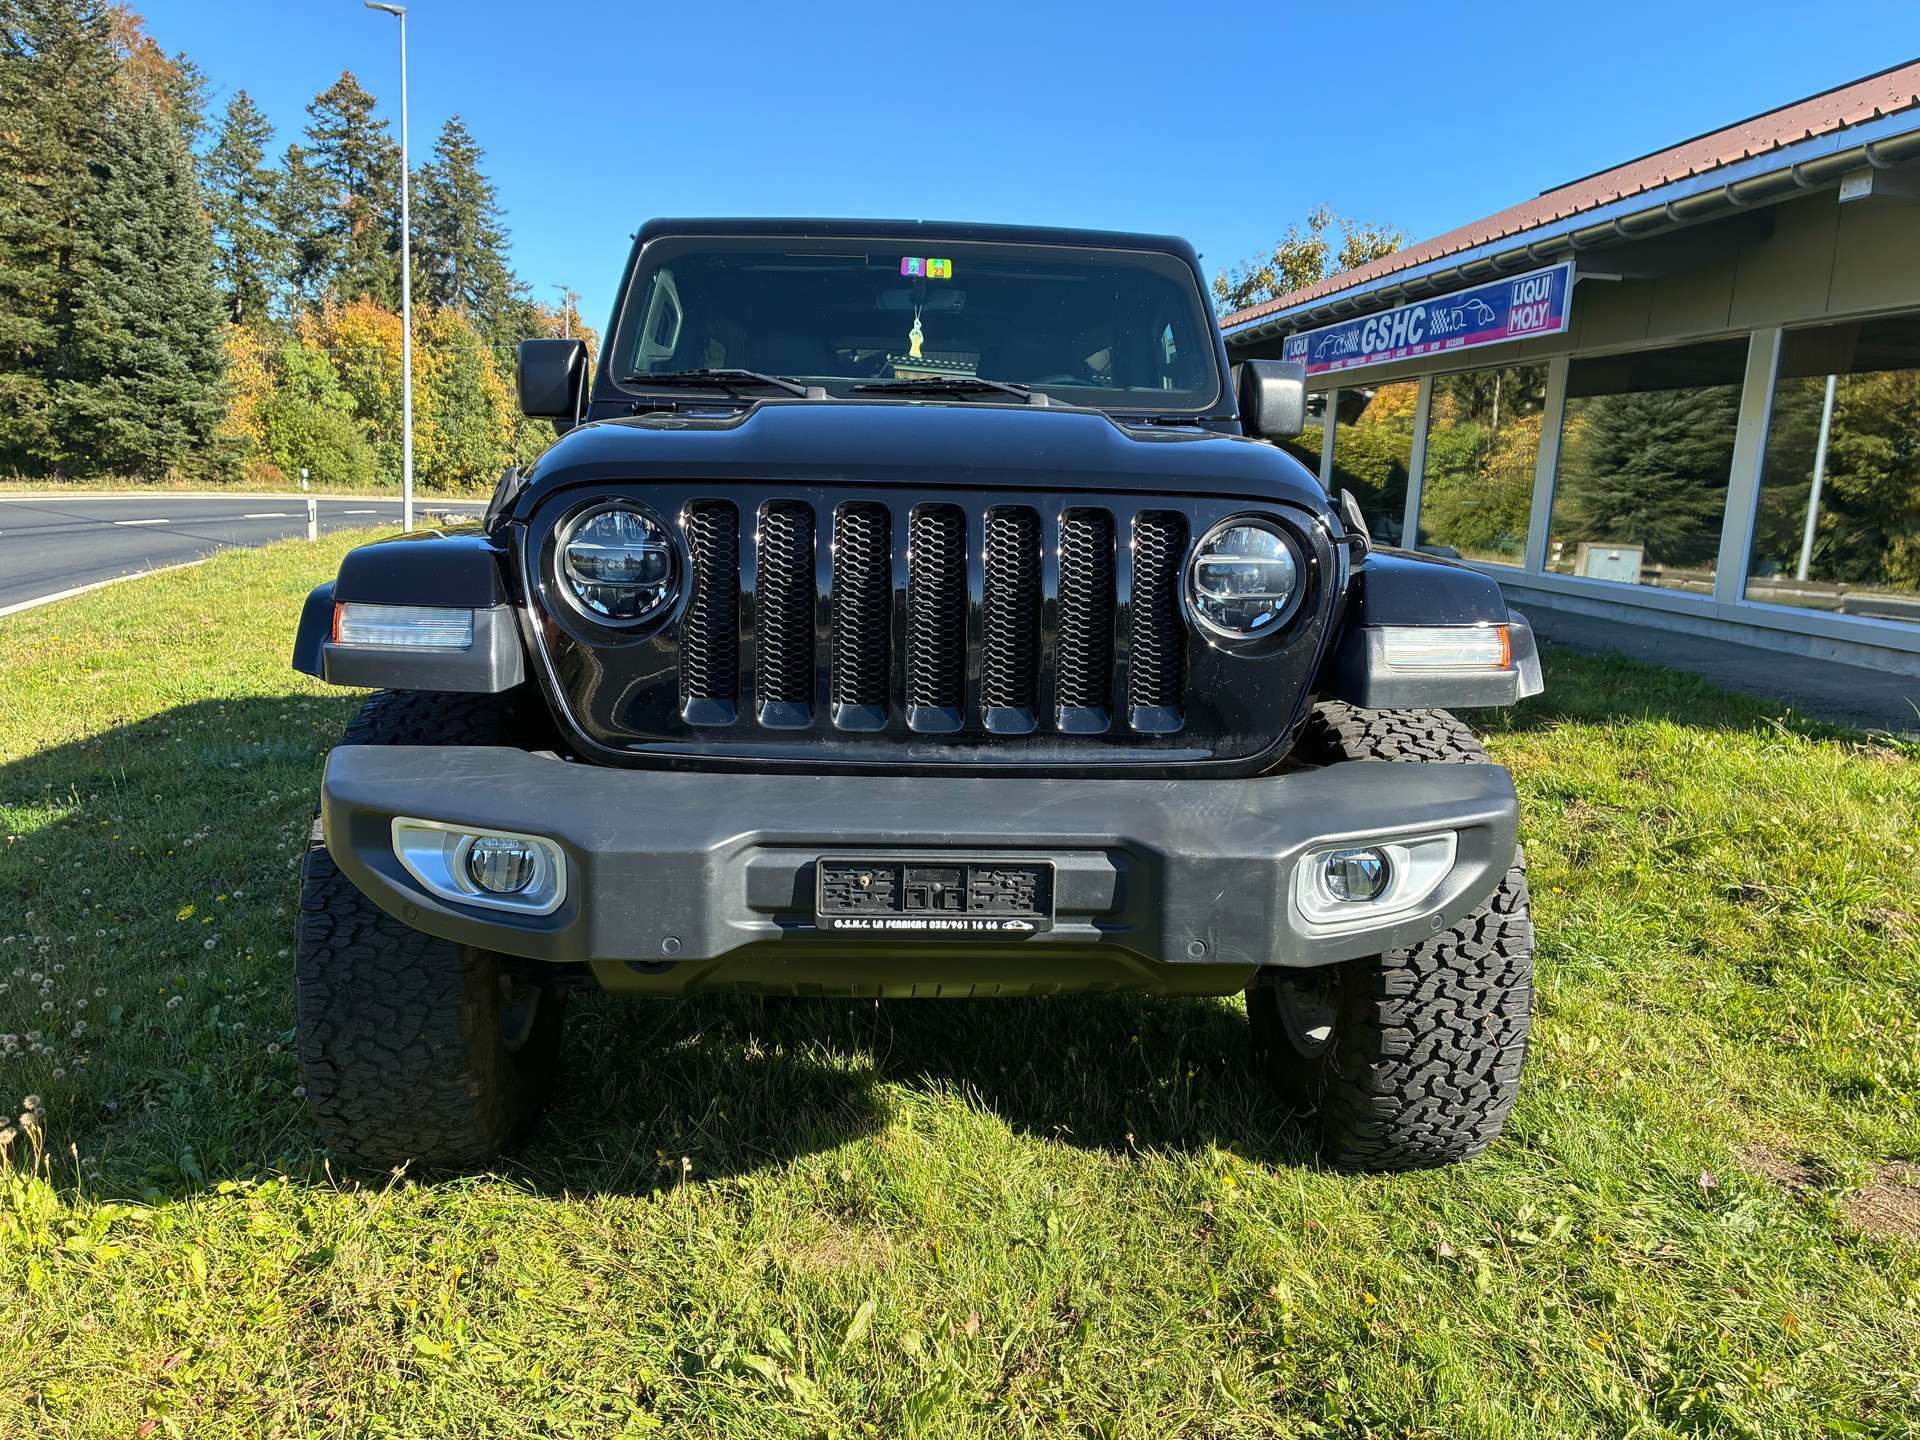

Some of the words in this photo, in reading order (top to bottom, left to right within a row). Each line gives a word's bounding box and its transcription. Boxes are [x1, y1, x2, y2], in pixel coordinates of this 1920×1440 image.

[908, 266, 920, 274] 22
[934, 268, 944, 276] 23
[1512, 275, 1551, 307] LIQUI
[1510, 302, 1549, 332] MOLY
[1361, 306, 1427, 354] GSHC
[1290, 337, 1309, 356] LIQUI
[1413, 345, 1425, 354] VENTE
[1445, 337, 1465, 348] OCCASION
[834, 919, 870, 929] G.S.H.C.
[872, 920, 884, 929] LA
[929, 920, 969, 930] 032/961
[971, 921, 983, 930] 16
[985, 921, 998, 930] 66
